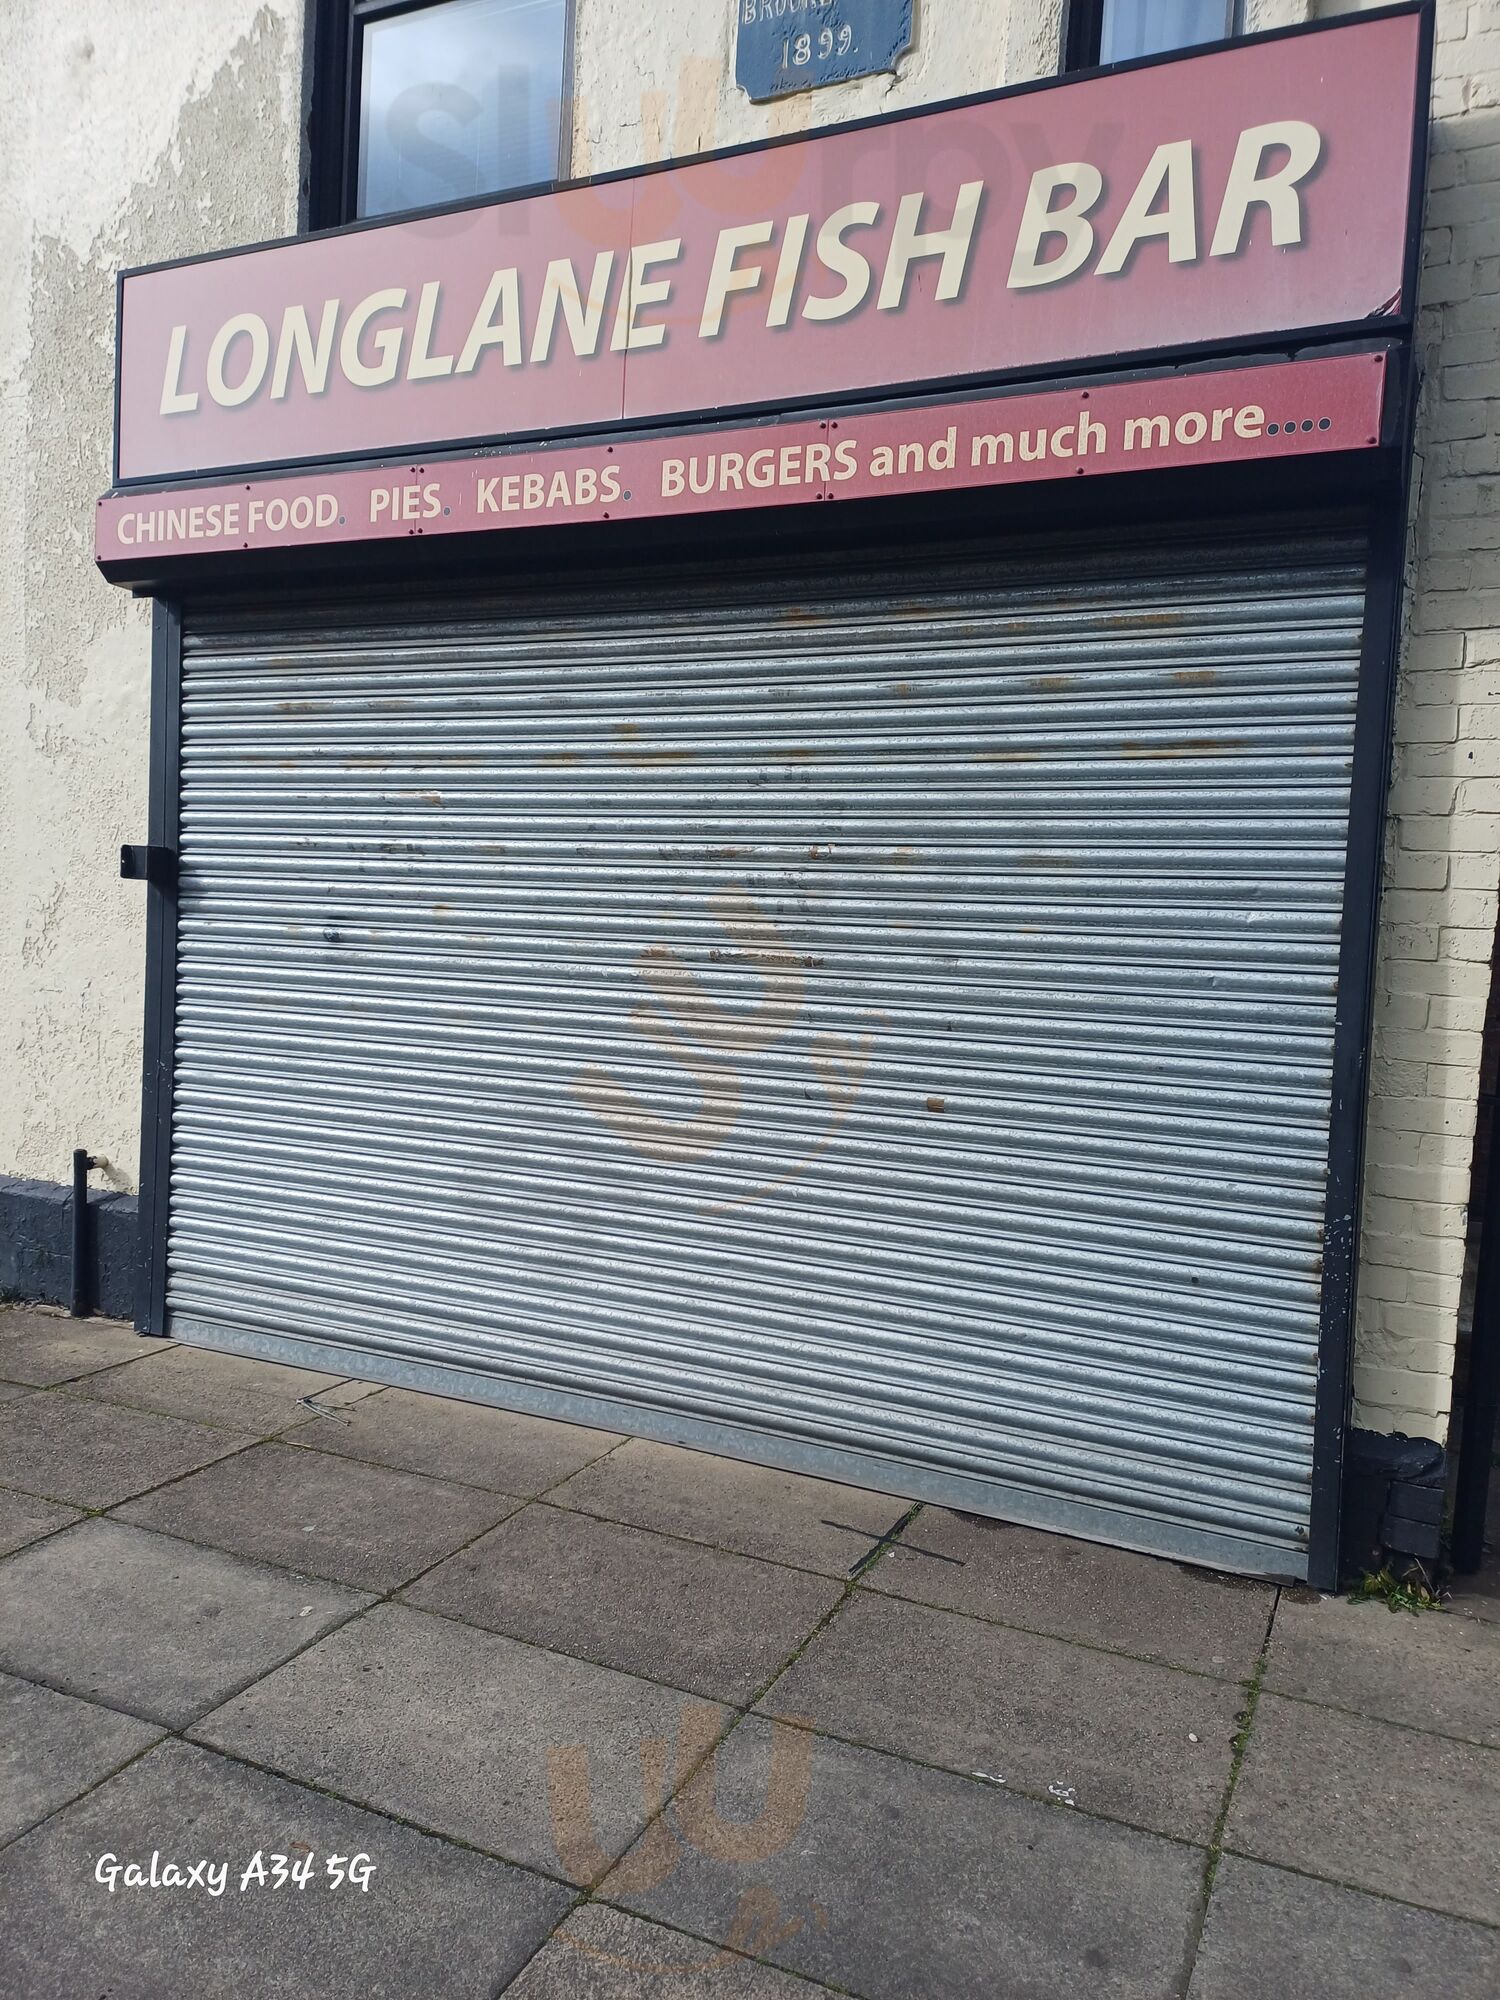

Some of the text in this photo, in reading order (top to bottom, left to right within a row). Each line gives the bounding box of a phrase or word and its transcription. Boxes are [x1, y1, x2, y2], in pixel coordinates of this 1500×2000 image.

[742, 0, 832, 24] BRO
[160, 121, 1321, 415] LONGLANE FISH BAR
[116, 503, 240, 545] CHINESE
[247, 494, 346, 534] FOOD.
[369, 483, 451, 523] PIES.
[476, 466, 632, 513] KEBABS.
[661, 440, 858, 497] BURGERS
[869, 426, 957, 477] and
[971, 411, 1106, 466] much
